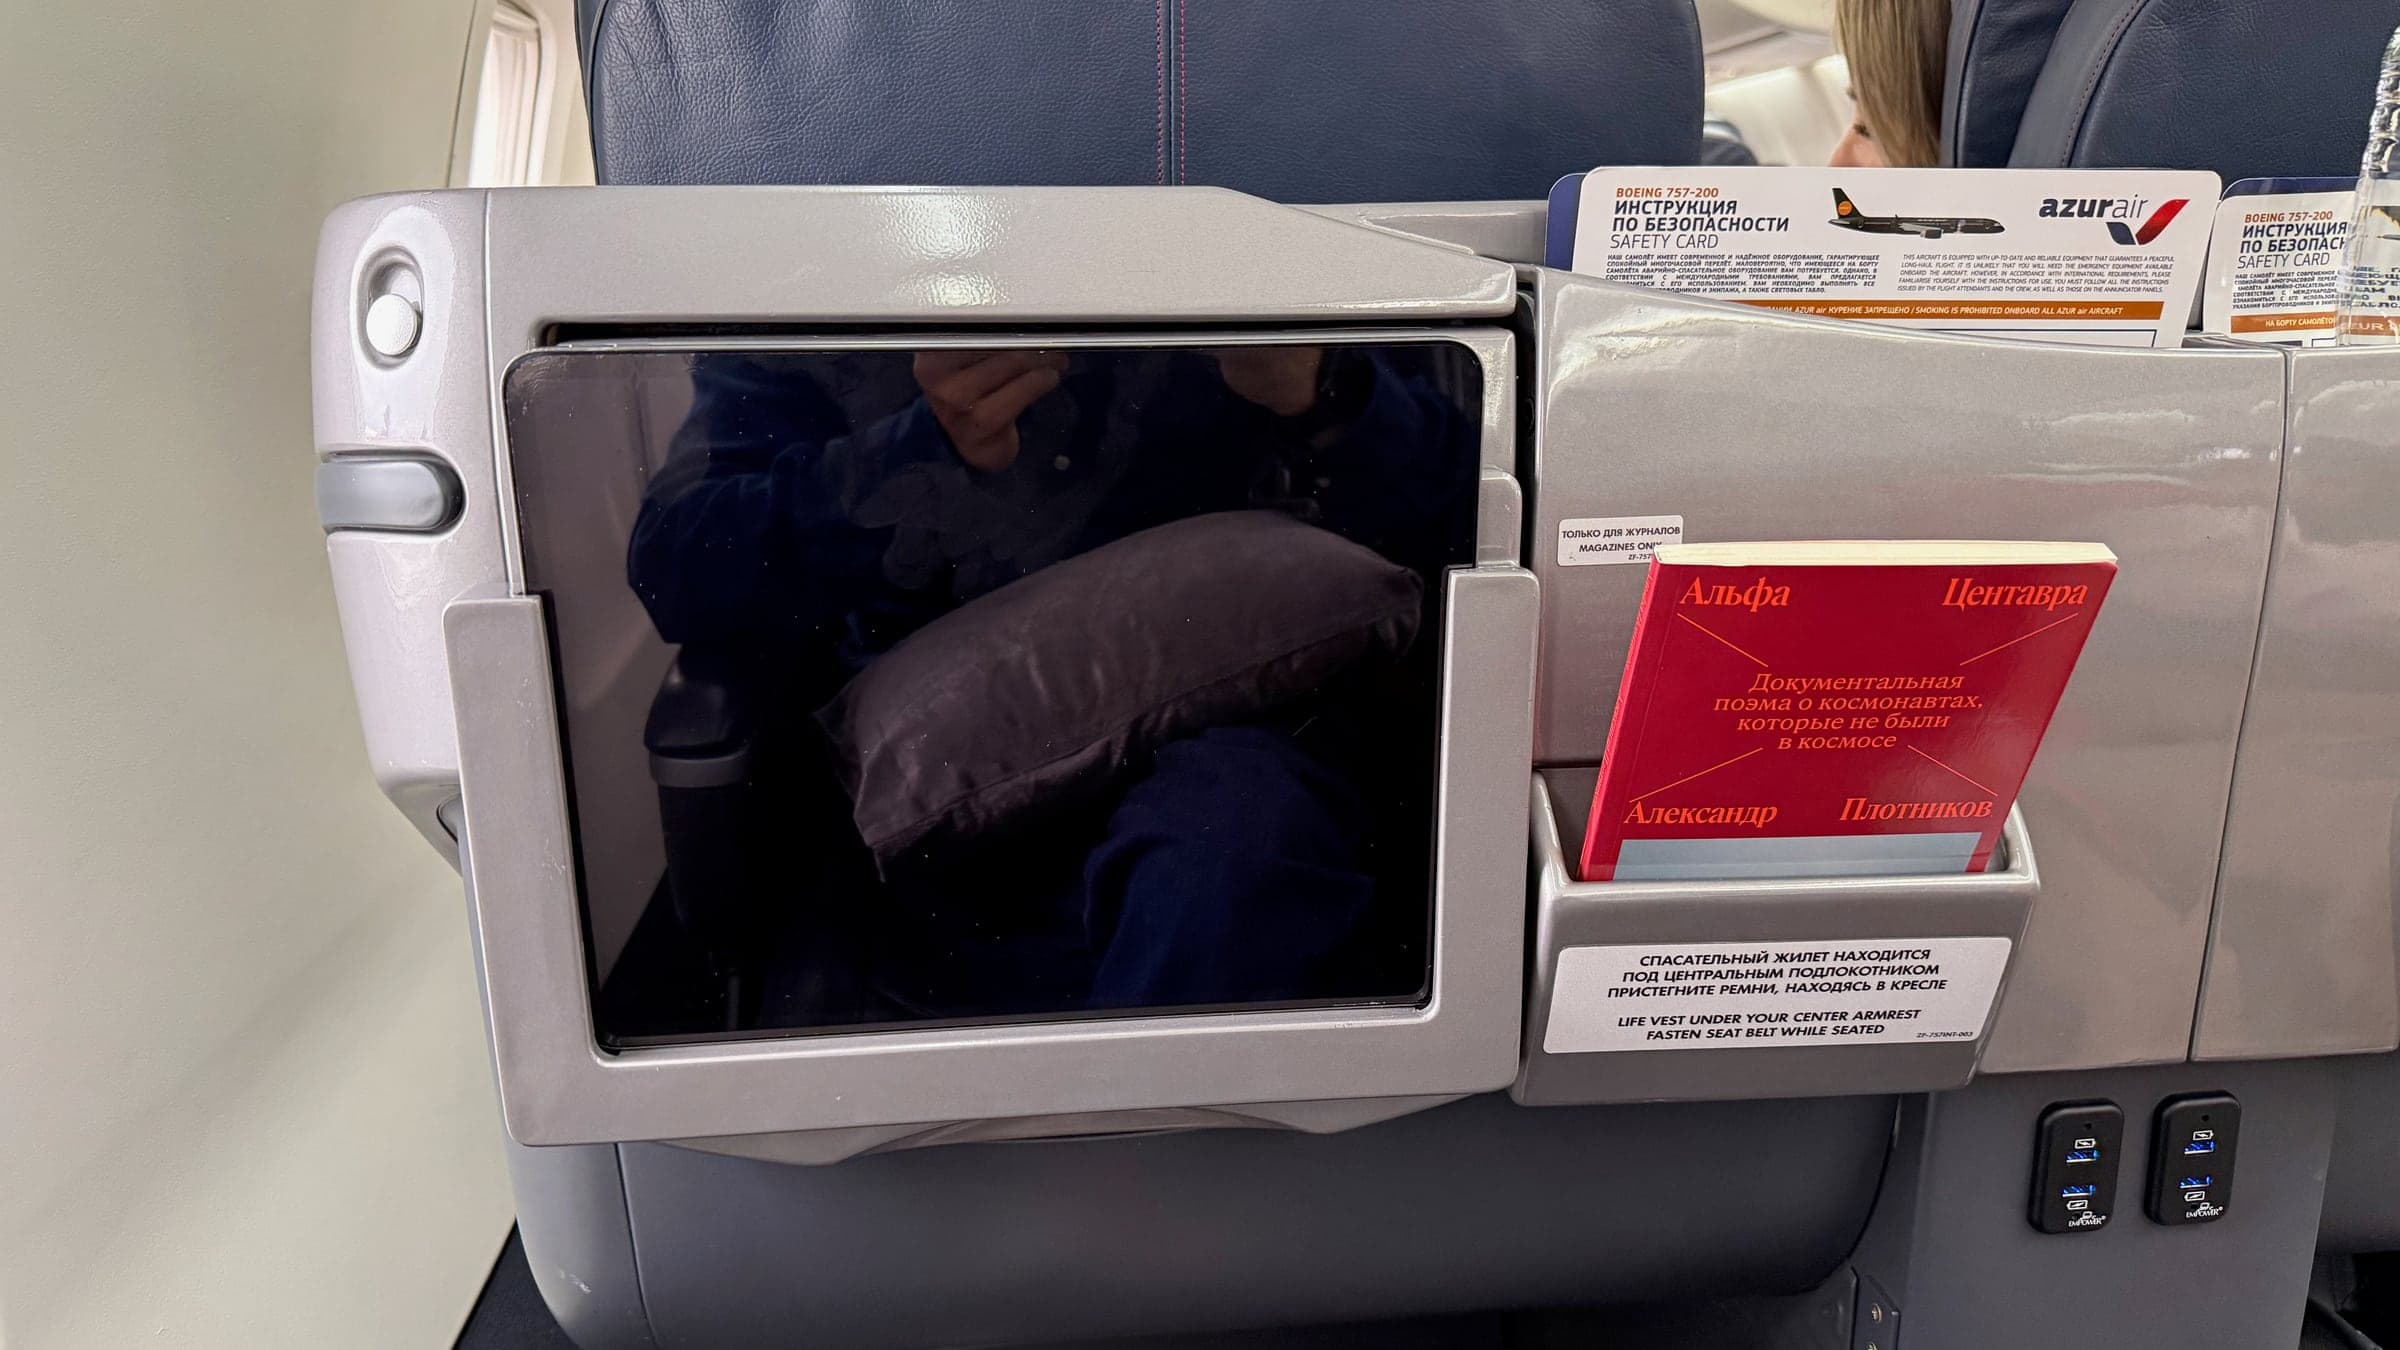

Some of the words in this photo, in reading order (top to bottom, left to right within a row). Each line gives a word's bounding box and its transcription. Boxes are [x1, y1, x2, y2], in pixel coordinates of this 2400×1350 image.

[1616, 187, 1662, 198] BOEING
[1666, 187, 1719, 198] 757-200
[1614, 200, 1737, 217] ИНСТРУКЦИЯ
[2244, 213, 2285, 223] BOEING
[2288, 211, 2333, 222] 757-200
[1612, 218, 1639, 232] ПО
[1645, 217, 1790, 232] БЕЗОПАСНОСТИ
[2242, 222, 2347, 239] ИНСТРУКЦИЯ
[1609, 234, 1671, 249] SAFETY
[1675, 234, 1719, 249] CARD
[2240, 239, 2262, 254] ПО
[2268, 236, 2346, 252] БЕЗОПАСН
[2237, 255, 2289, 269] SAFETY
[2293, 253, 2330, 266] CARD
[1794, 306, 1816, 314] AZUR
[1816, 306, 1827, 314] air
[1828, 306, 1861, 314] КУРЕНИЕ
[2298, 317, 2335, 326] САМОЛЁТО
[1562, 530, 1600, 539] ТОЛЬКО
[1603, 529, 1623, 538] ДЛЯ
[1625, 527, 1681, 536] ЖУРНАЛОВ
[1579, 543, 1635, 552] MAGAZINES
[1680, 577, 1791, 613] Альфа
[1943, 578, 2088, 613] Центавра
[1748, 673, 1965, 694] Документальная
[1714, 697, 1792, 712] поэма
[1798, 697, 1812, 711] о
[1819, 695, 1983, 711] космонавтах,
[1737, 715, 1844, 733] которые
[1850, 715, 1878, 729] не
[1884, 712, 1950, 729] были
[1778, 737, 1791, 749] в
[1797, 735, 1897, 749] космосе
[1624, 802, 1777, 828] Александр
[1840, 798, 1993, 821] Плотников
[1640, 950, 1768, 967] СПАСАТЕЛЬНЫЙ
[1773, 951, 1829, 964] ЖИЛЕТ
[1833, 949, 1931, 963] НАХОДИТСЯ
[1622, 970, 1659, 984] ПОД
[1663, 967, 1783, 983] ЦЕНТРАЛЬНЫМ
[1788, 965, 1939, 979] ПОДЛОКОТНИКОМ
[1607, 983, 1715, 998] ПРИСТЕГНИТЕ
[1719, 982, 1779, 997] РЕМНИ,
[1785, 980, 1872, 994] НАХОДЯСЬ
[1876, 980, 1886, 991] В
[1890, 978, 1948, 991] КРЕСЛЕ
[1617, 1015, 1646, 1027] LIFE
[1651, 1013, 1686, 1026] VEST
[1690, 1012, 1742, 1025] UNDER
[1746, 1011, 1788, 1024] YOUR
[1793, 1010, 1848, 1023] CENTER
[1853, 1009, 1921, 1021] ARMREST
[1646, 1028, 1701, 1040] FASTEN
[1706, 1027, 1742, 1039] SEAT
[1745, 1026, 1778, 1038] BELT
[1779, 1024, 1828, 1037] WHILE
[1831, 1023, 1885, 1035] SEATED
